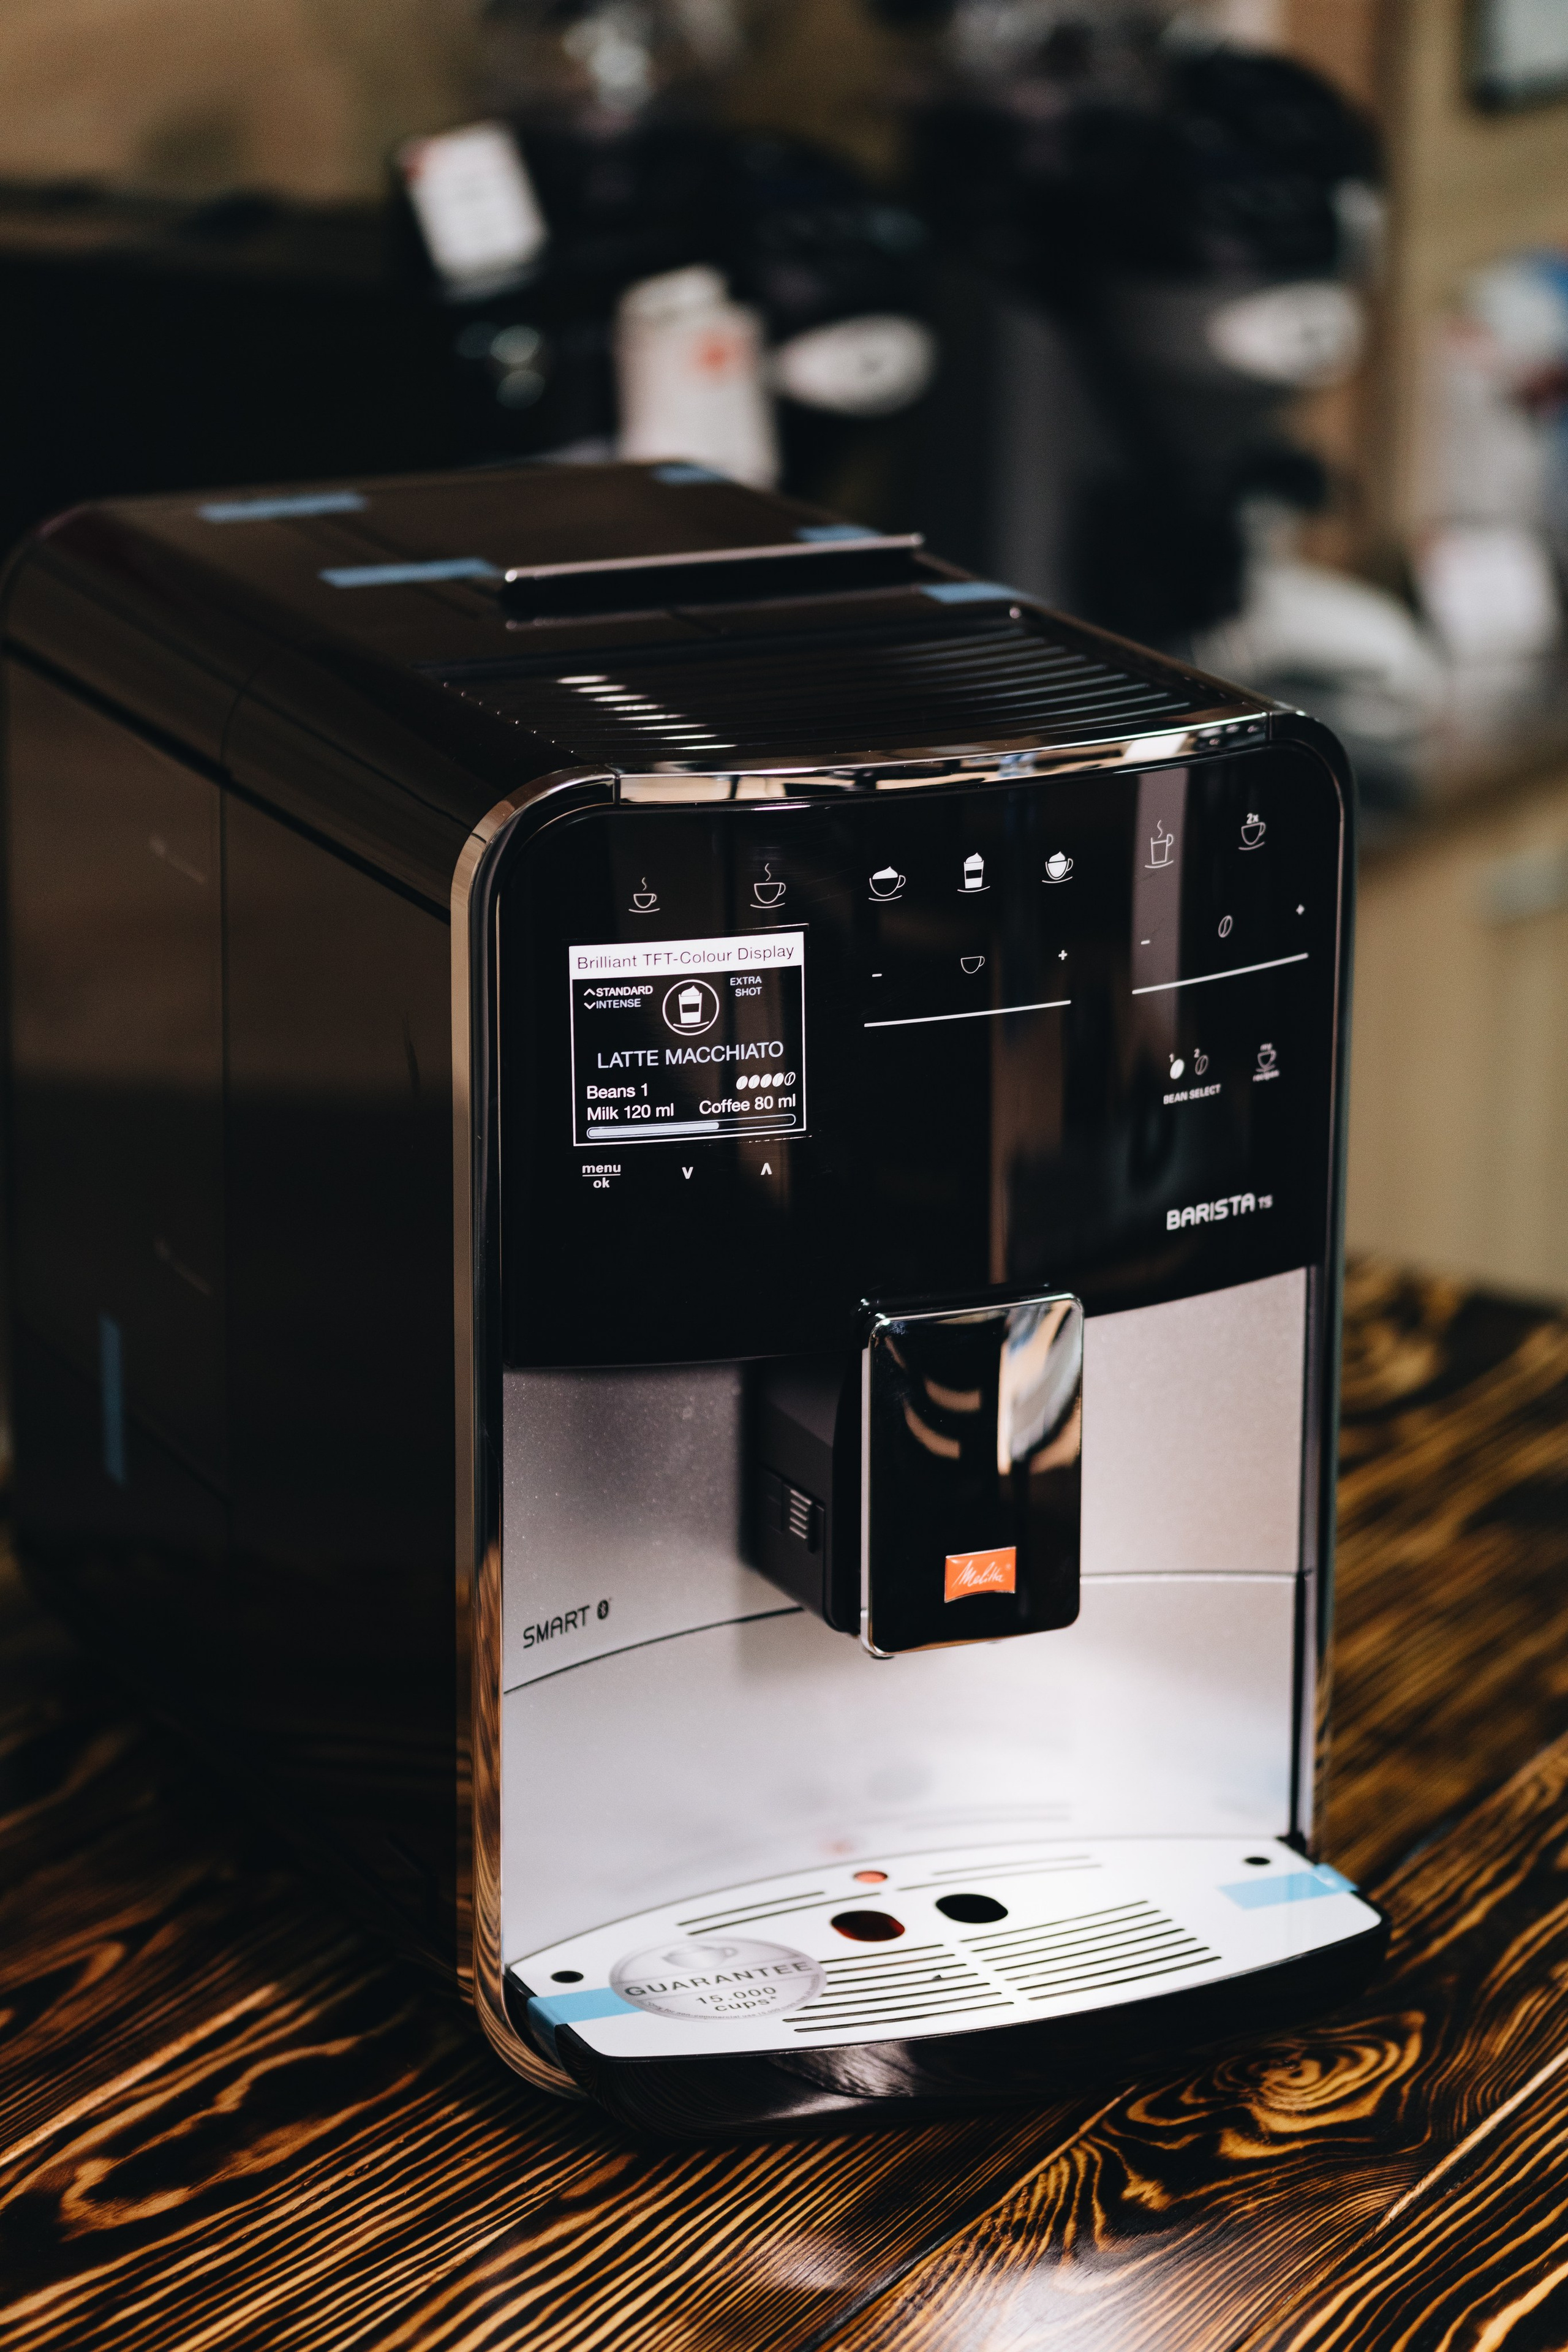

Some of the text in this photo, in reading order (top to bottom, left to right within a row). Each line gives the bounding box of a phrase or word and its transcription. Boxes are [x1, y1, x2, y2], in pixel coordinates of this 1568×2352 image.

[1246, 813, 1259, 824] 2x
[578, 946, 795, 970] Brilliant TFT-Colour Display
[730, 976, 762, 987] EXTRA
[596, 985, 654, 997] STANDARD
[735, 987, 763, 997] SHOT
[596, 998, 641, 1009] INTENSE
[597, 1041, 784, 1069] LATTE MACCHIATO
[1193, 1047, 1200, 1058] 2
[586, 1083, 648, 1099] Beans 1
[1163, 1083, 1221, 1104] BEAN SELECT
[587, 1102, 674, 1120] Milk 120 ml
[699, 1093, 796, 1114] Coffee 80 ml
[582, 1163, 621, 1174] menu
[593, 1177, 610, 1188] ok
[1166, 1192, 1256, 1231] BARISTA
[951, 1559, 1005, 1588] Melitta
[523, 1605, 590, 1648] SMART
[625, 1961, 813, 1997] GUARANTEE
[695, 1986, 777, 2005] 15.000
